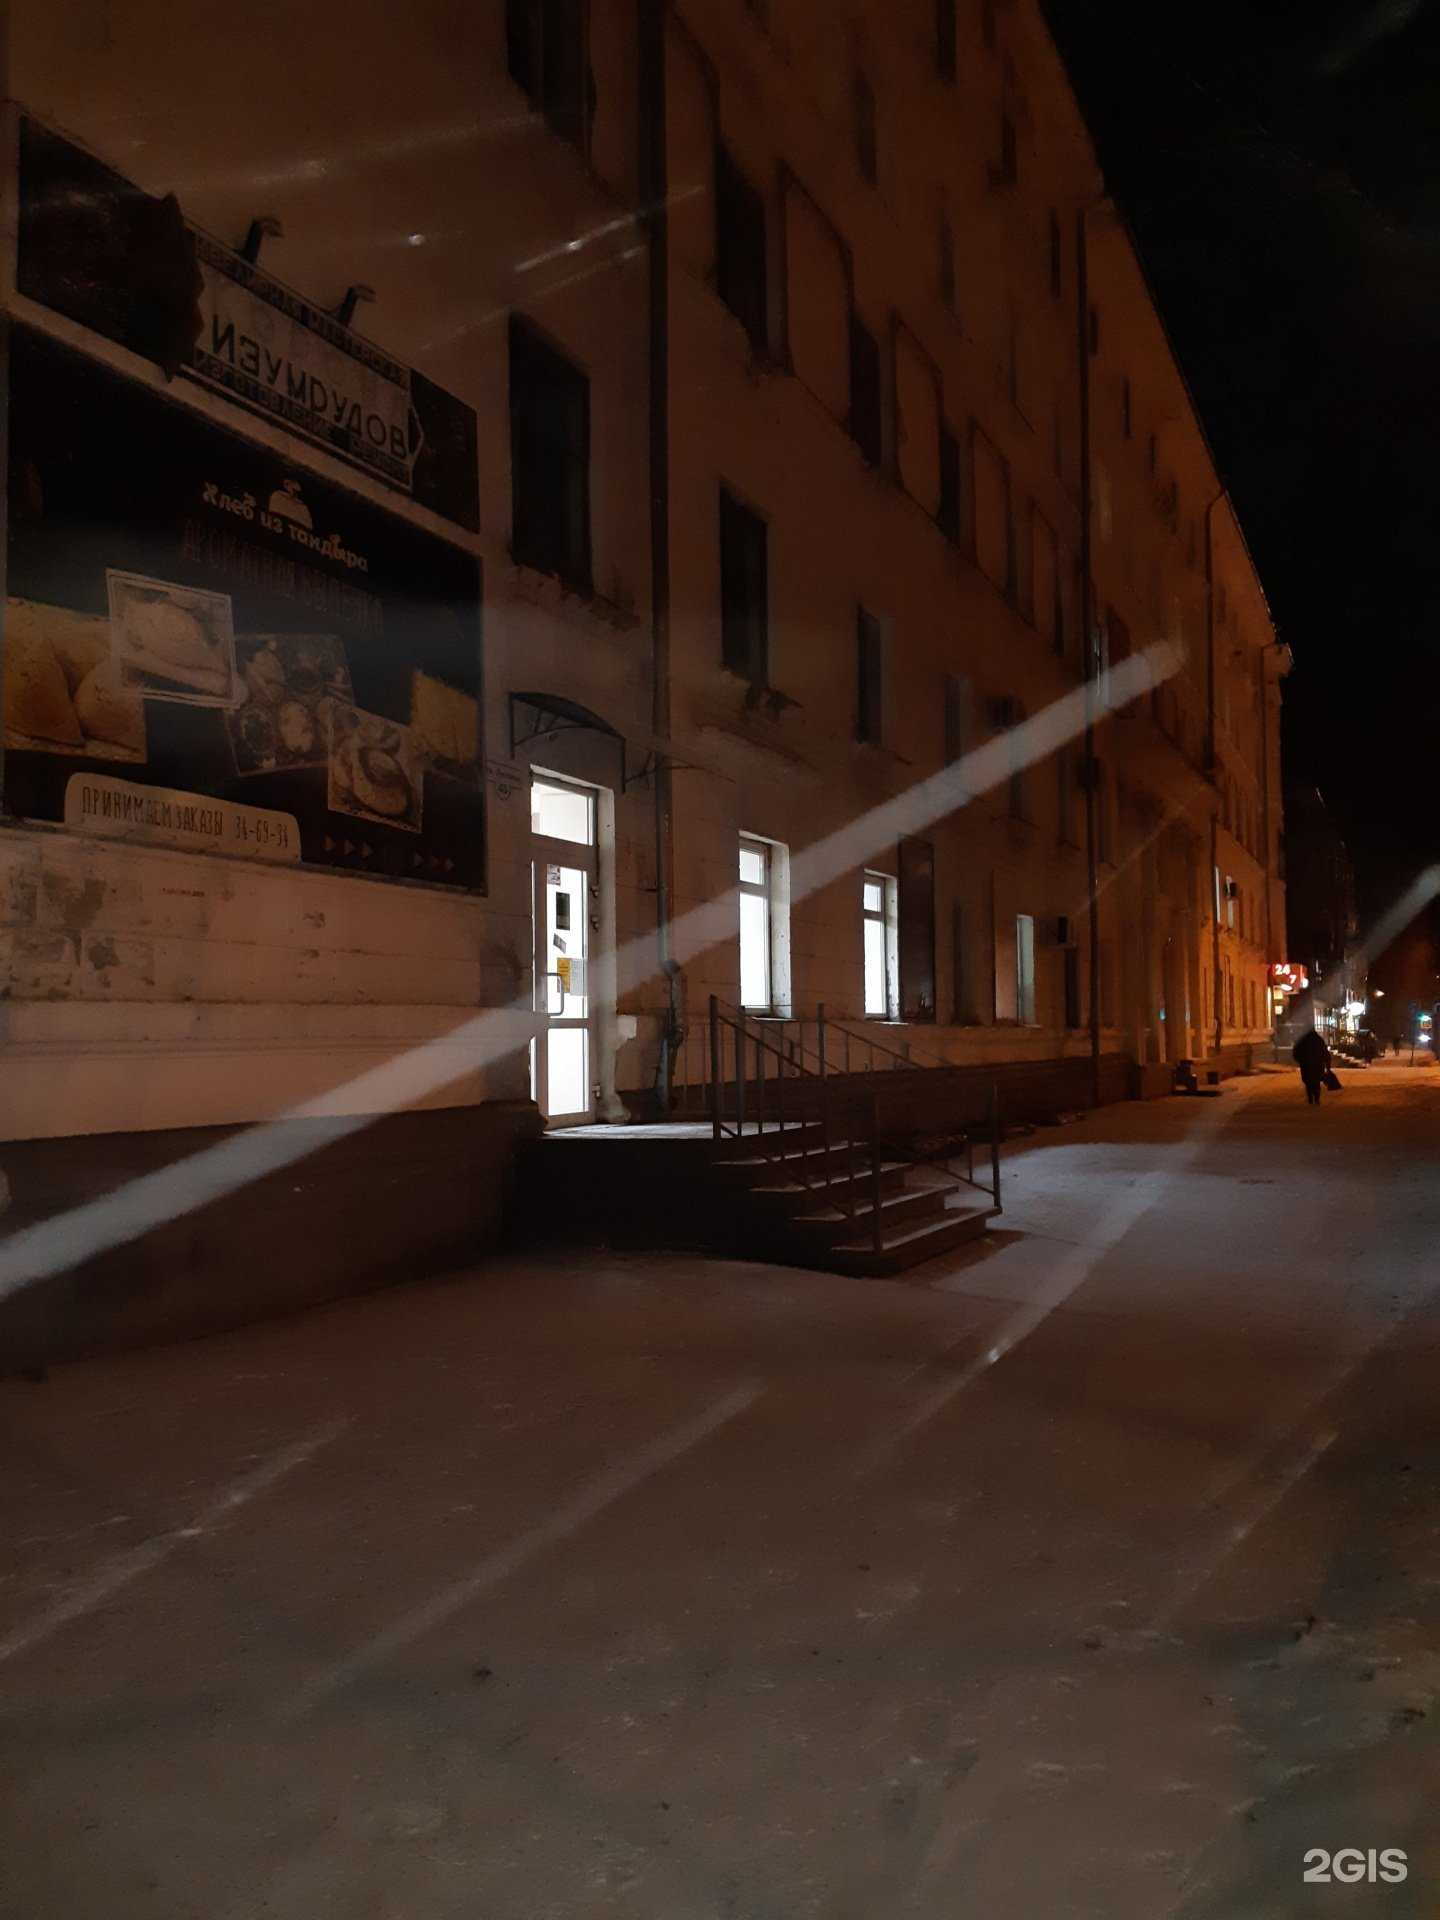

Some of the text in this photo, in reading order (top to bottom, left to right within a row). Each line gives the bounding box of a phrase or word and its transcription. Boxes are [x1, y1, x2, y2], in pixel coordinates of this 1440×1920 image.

[201, 481, 369, 573] Хлеб из тандыра
[81, 786, 172, 829] ПРИНИМАЕМ
[175, 804, 224, 836] ЗАКАЗЫ
